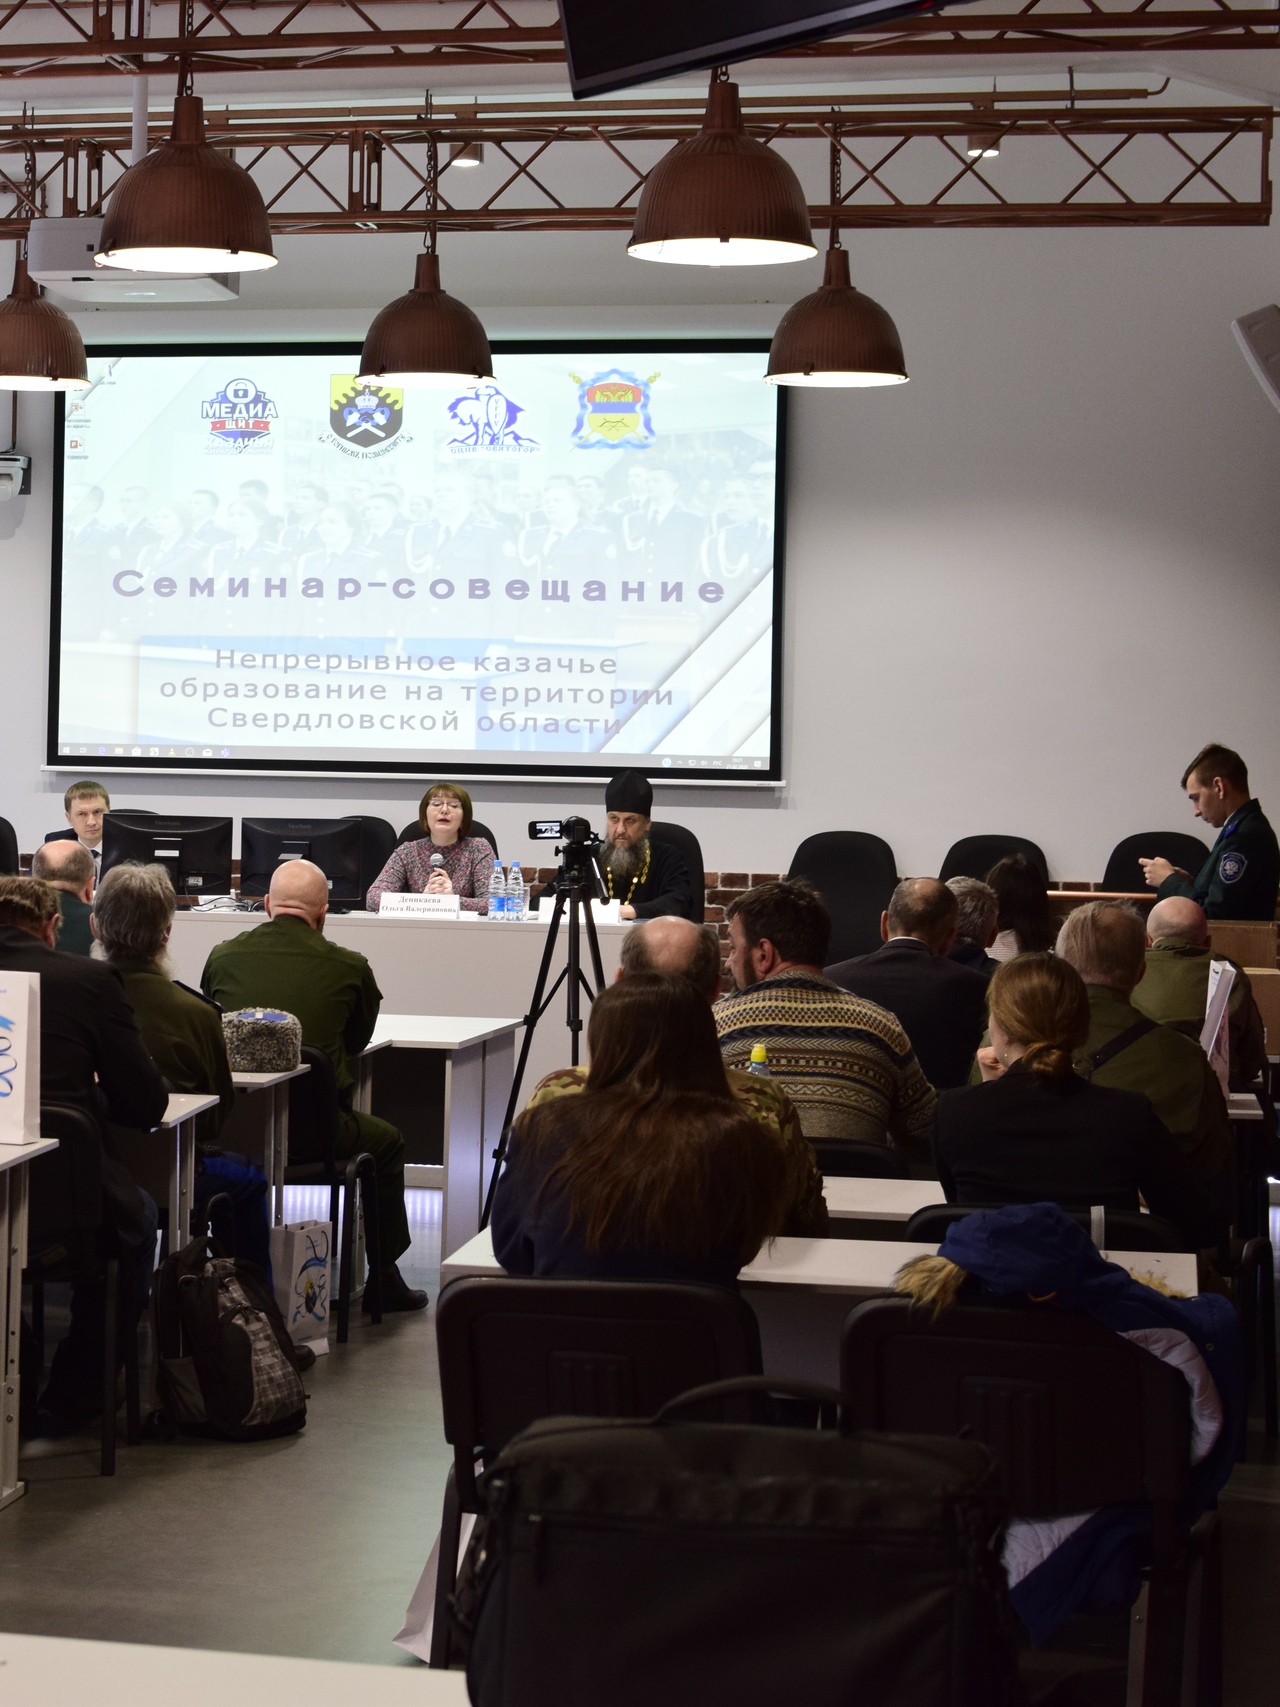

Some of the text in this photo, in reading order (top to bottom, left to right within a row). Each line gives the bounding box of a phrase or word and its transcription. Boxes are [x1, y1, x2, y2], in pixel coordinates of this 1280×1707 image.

[201, 400, 278, 420] МЕДИА
[225, 418, 255, 429] ЩИТ
[112, 569, 725, 604] Семинар-совещание
[215, 648, 617, 675] Непрерывное казачье
[159, 677, 673, 709] образование на территории
[207, 707, 621, 735] Свердловской области
[381, 904, 457, 914] Ольга Валериановна
[398, 896, 442, 904] Деникаева
